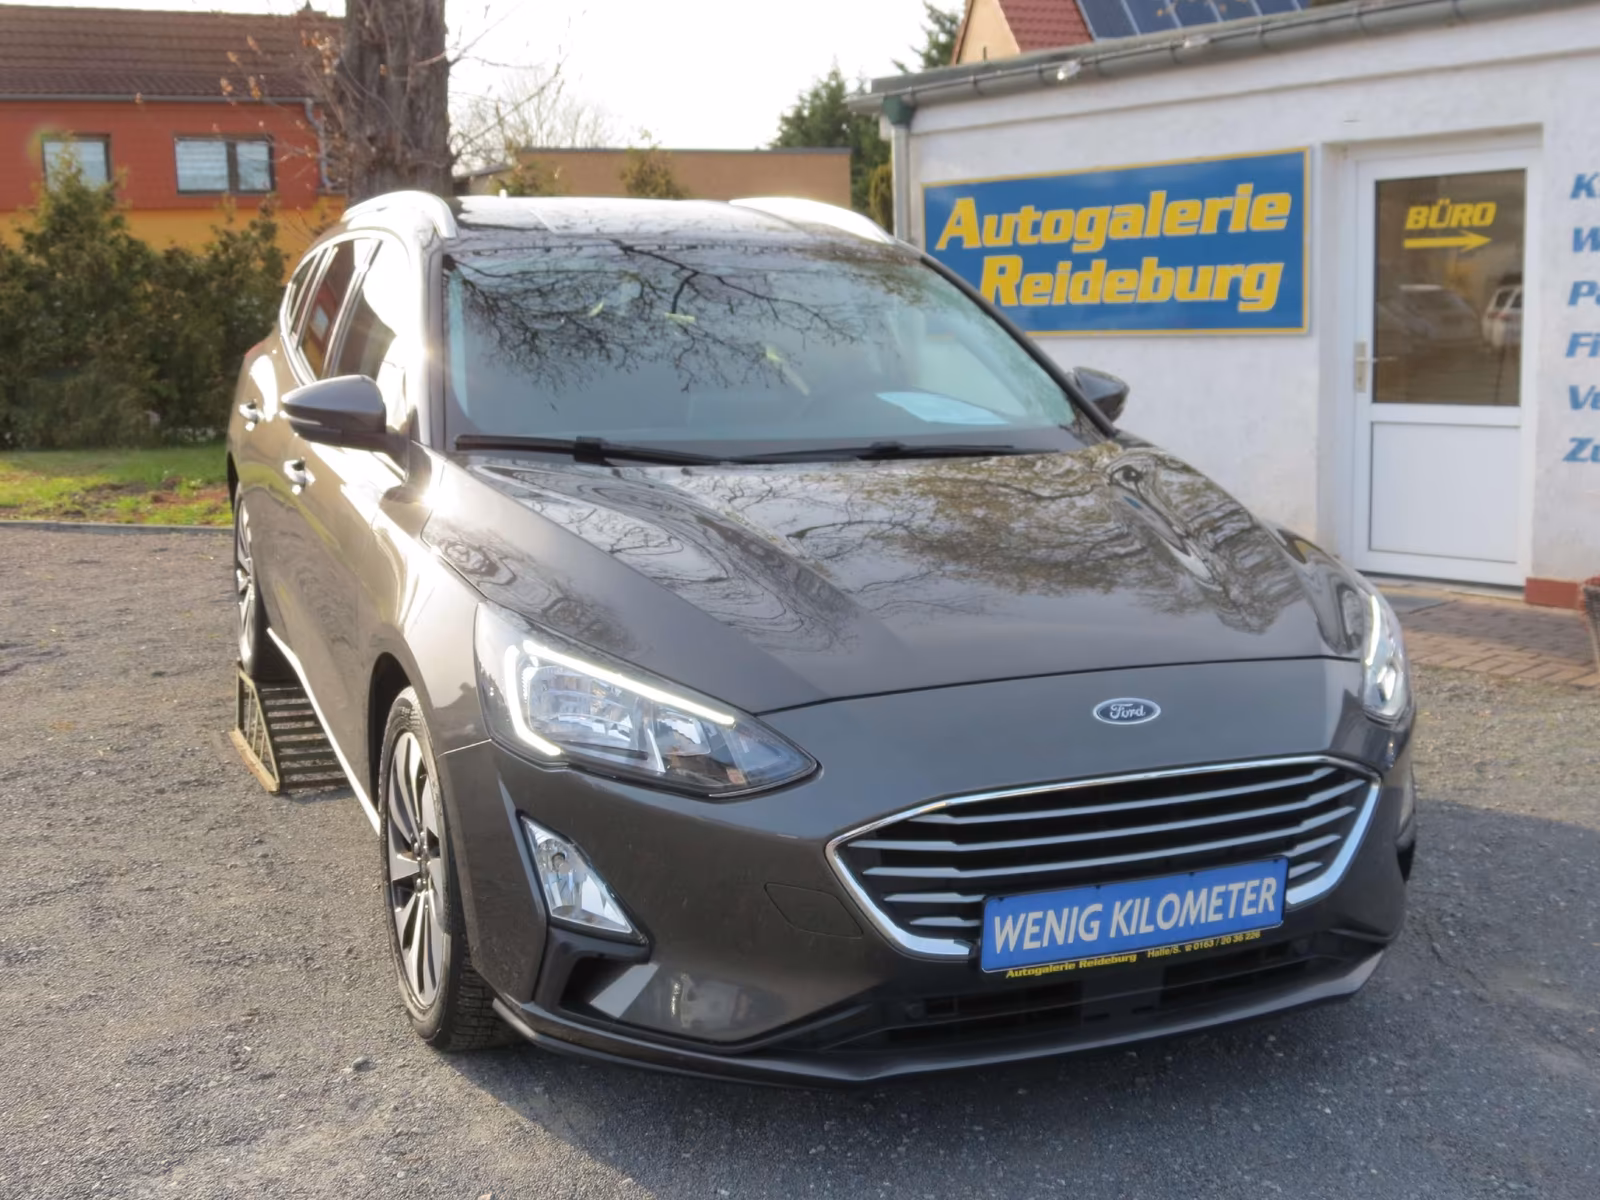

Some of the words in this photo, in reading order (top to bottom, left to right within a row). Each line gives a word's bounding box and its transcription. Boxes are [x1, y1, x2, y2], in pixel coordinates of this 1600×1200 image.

[935, 183, 1292, 253] Autogalerie
[1405, 198, 1497, 230] BÜRO
[979, 255, 1284, 312] Reideburg
[1109, 703, 1146, 719] Ford
[994, 903, 1103, 954] WENIG
[1109, 877, 1278, 938] KILOMETER
[1005, 962, 1076, 978] Autogalerie
[1078, 953, 1137, 969] Reideburg
